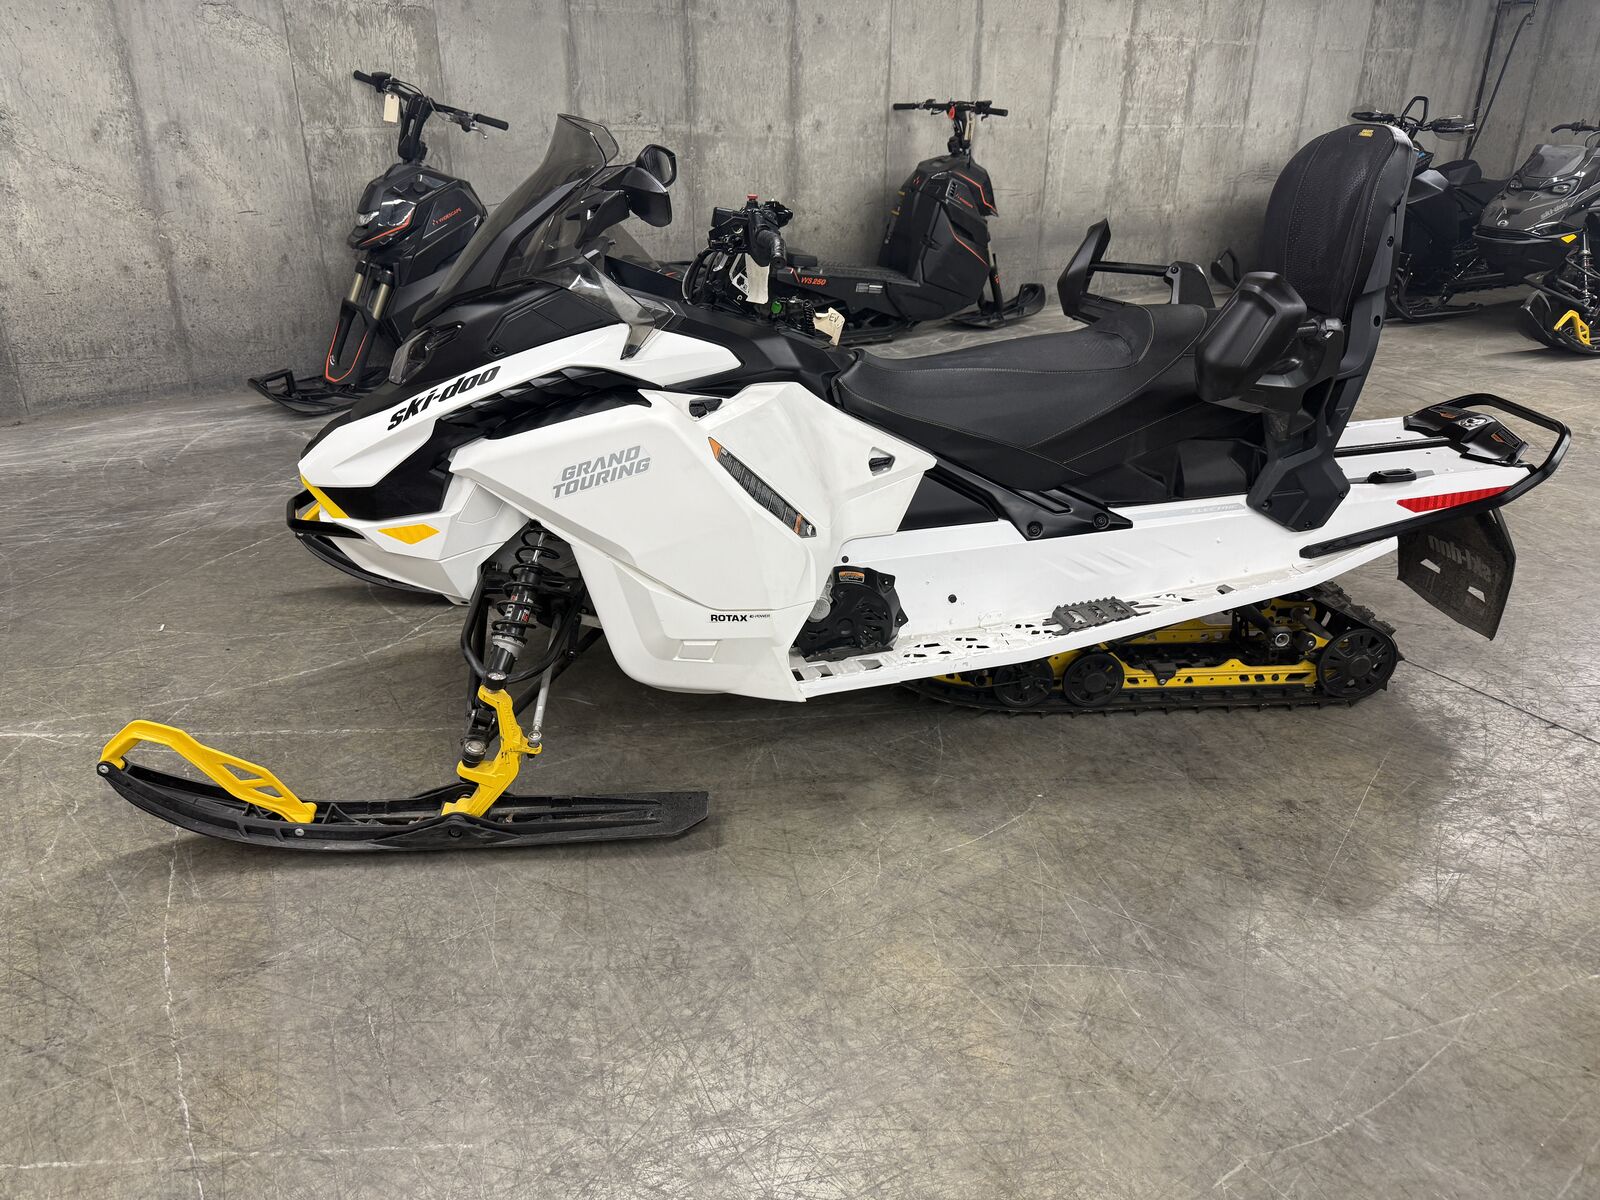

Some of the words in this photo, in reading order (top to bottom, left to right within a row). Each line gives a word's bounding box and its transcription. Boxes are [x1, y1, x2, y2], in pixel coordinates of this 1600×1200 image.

[812, 278, 827, 286] 250
[387, 366, 501, 431] ski-doo
[553, 457, 651, 499] TOURING
[561, 445, 641, 481] GRAND
[711, 614, 748, 622] ROTAX
